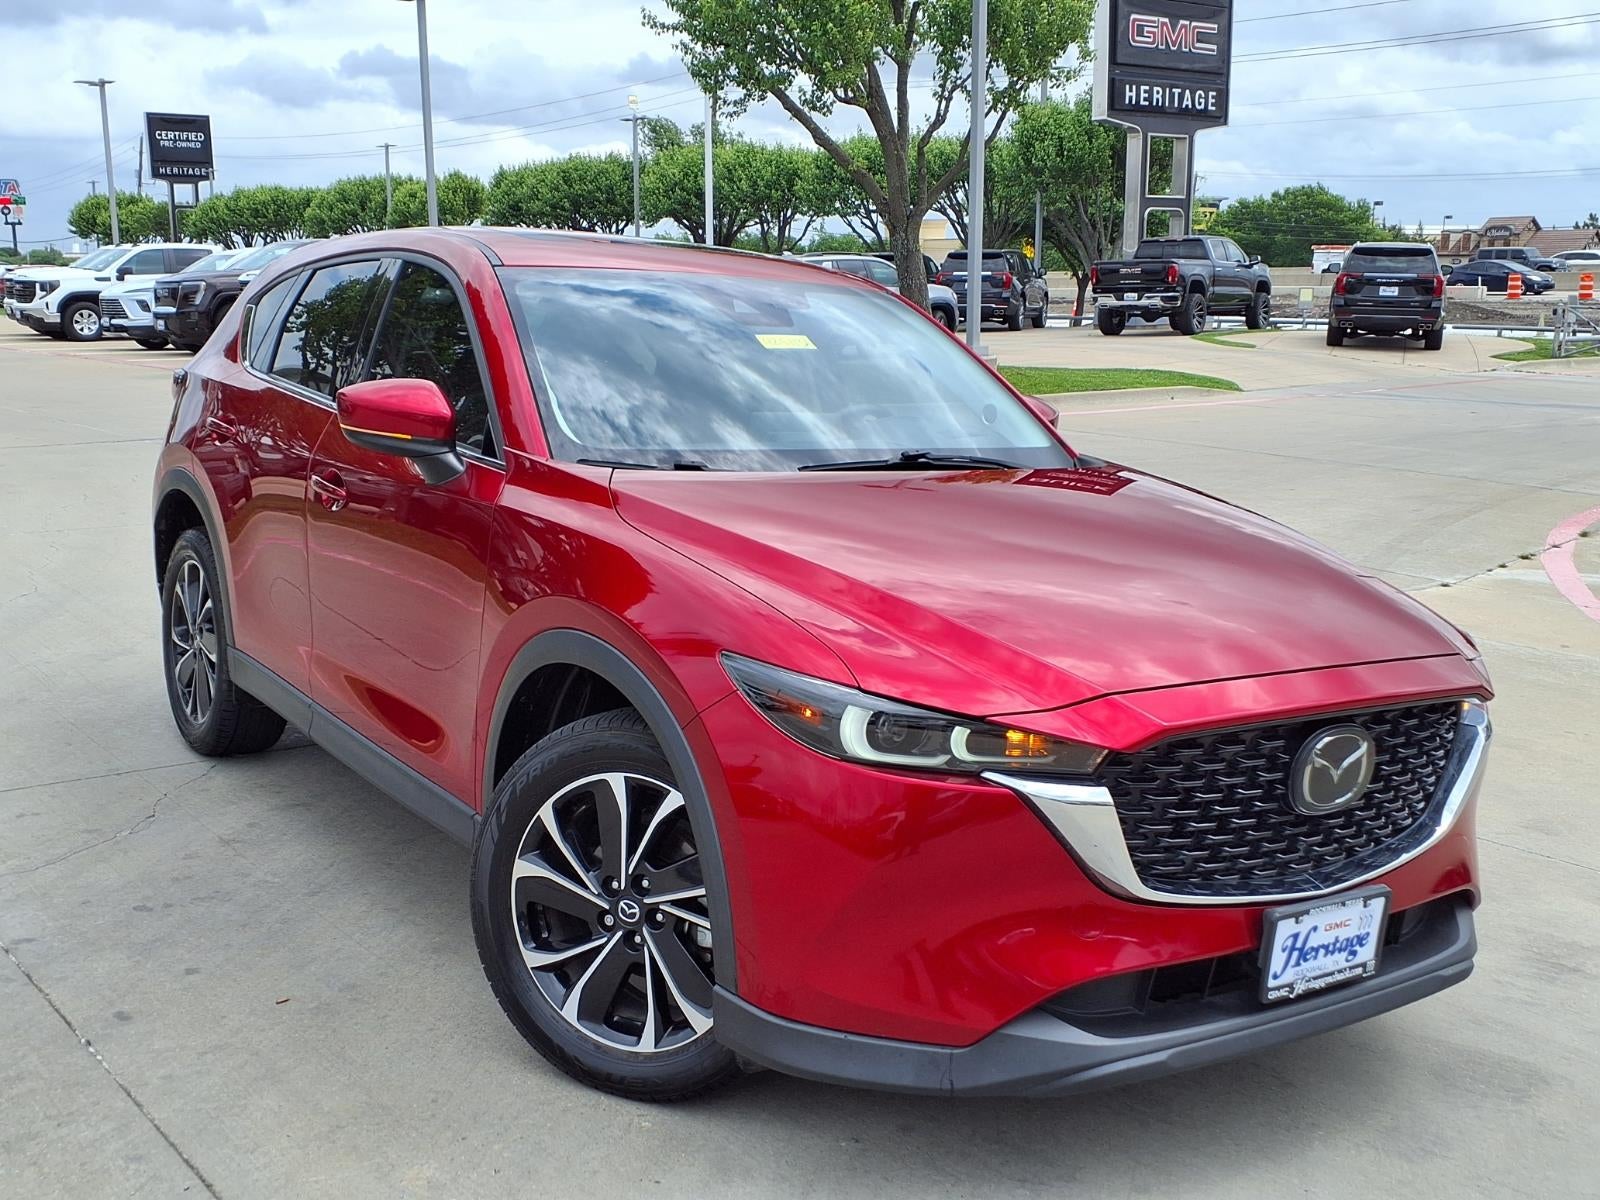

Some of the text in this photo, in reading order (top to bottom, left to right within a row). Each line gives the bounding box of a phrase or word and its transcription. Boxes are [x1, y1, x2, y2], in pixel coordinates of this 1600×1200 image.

[1129, 13, 1218, 55] GMC
[1125, 84, 1217, 111] HERITAGE
[155, 130, 205, 141] CERTIFIED
[160, 140, 201, 149] PRE-OWNED
[159, 167, 207, 176] HERITAGE
[1324, 918, 1352, 933] GMC
[1271, 925, 1370, 981] Heritage
